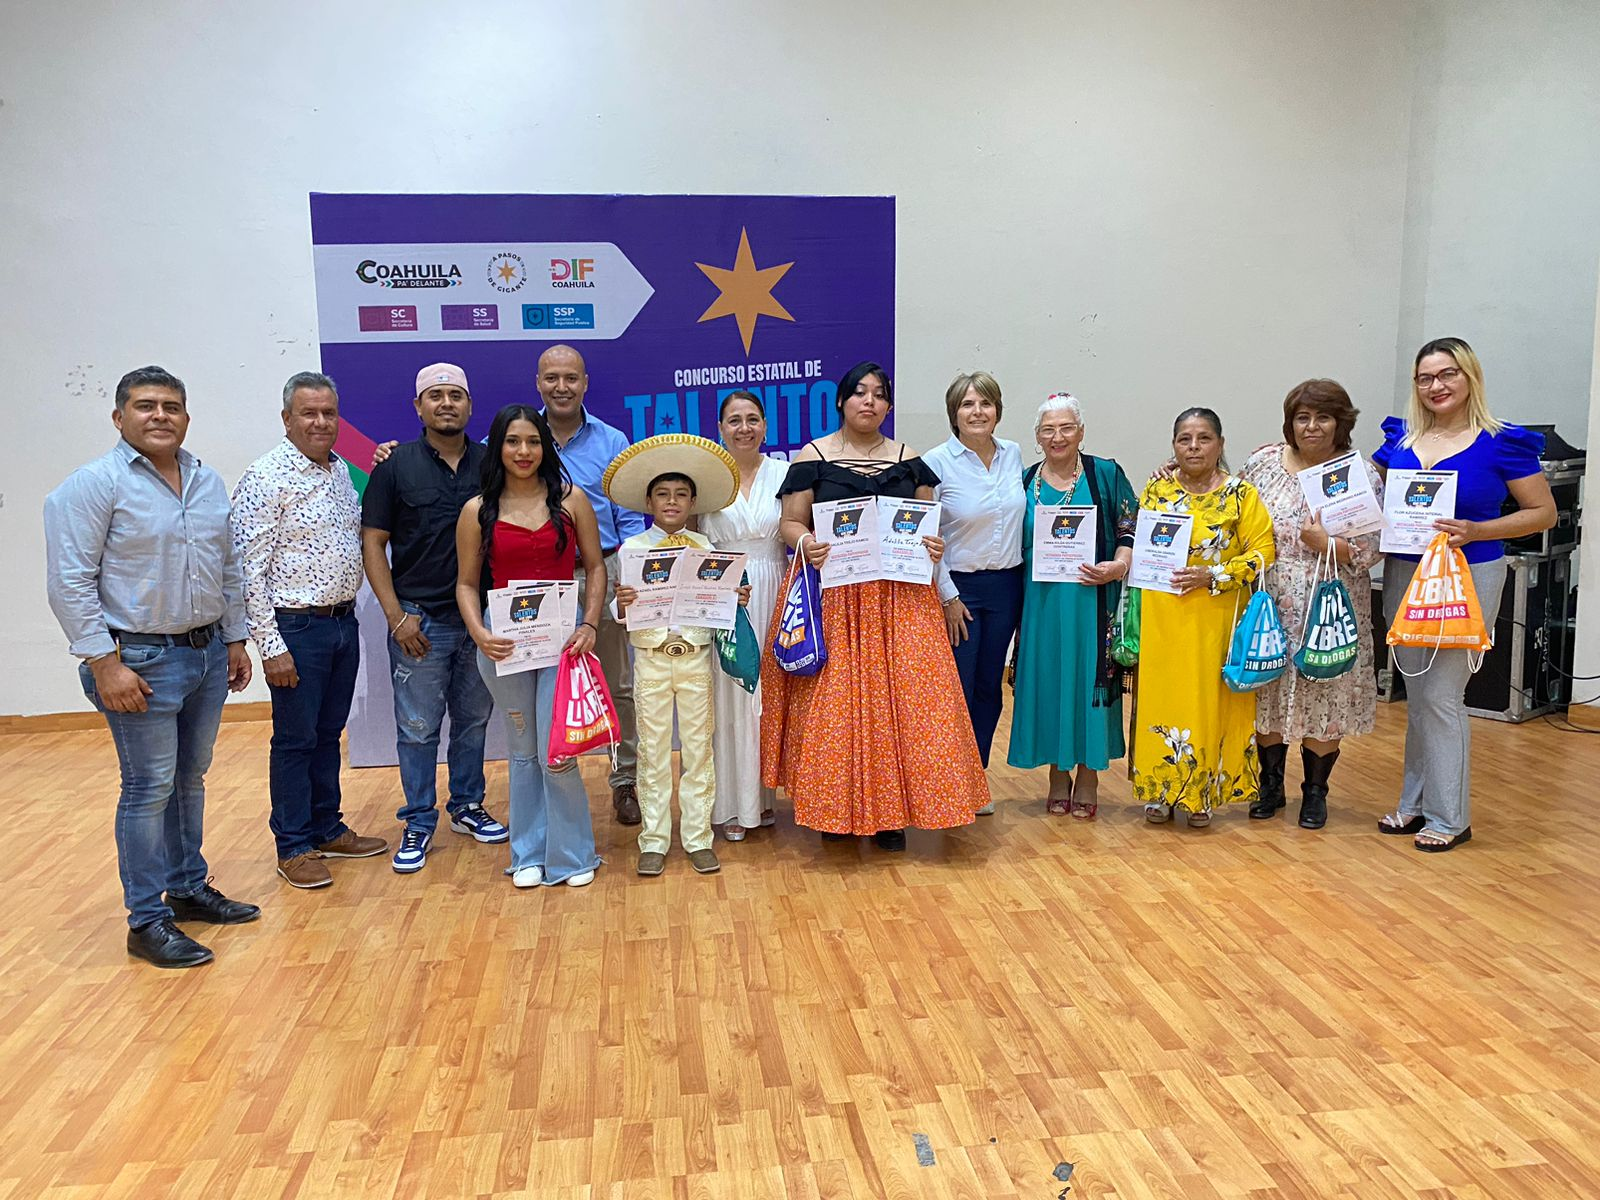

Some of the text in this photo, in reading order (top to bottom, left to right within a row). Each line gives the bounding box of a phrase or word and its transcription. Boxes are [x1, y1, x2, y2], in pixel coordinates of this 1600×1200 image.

[498, 252, 522, 262] PASOS
[356, 259, 462, 284] COAHUILA
[551, 258, 594, 281] DIF
[487, 276, 527, 294] DE GIGANTE
[552, 281, 595, 289] COAHUILA
[391, 308, 406, 318] SC
[472, 307, 488, 317] SS
[553, 307, 576, 317] SSP
[674, 359, 822, 388] CONCURSO ESTATAL DE
[1407, 573, 1467, 606] LIBRE
[1408, 609, 1425, 619] SIN
[1306, 614, 1358, 652] LBRE
